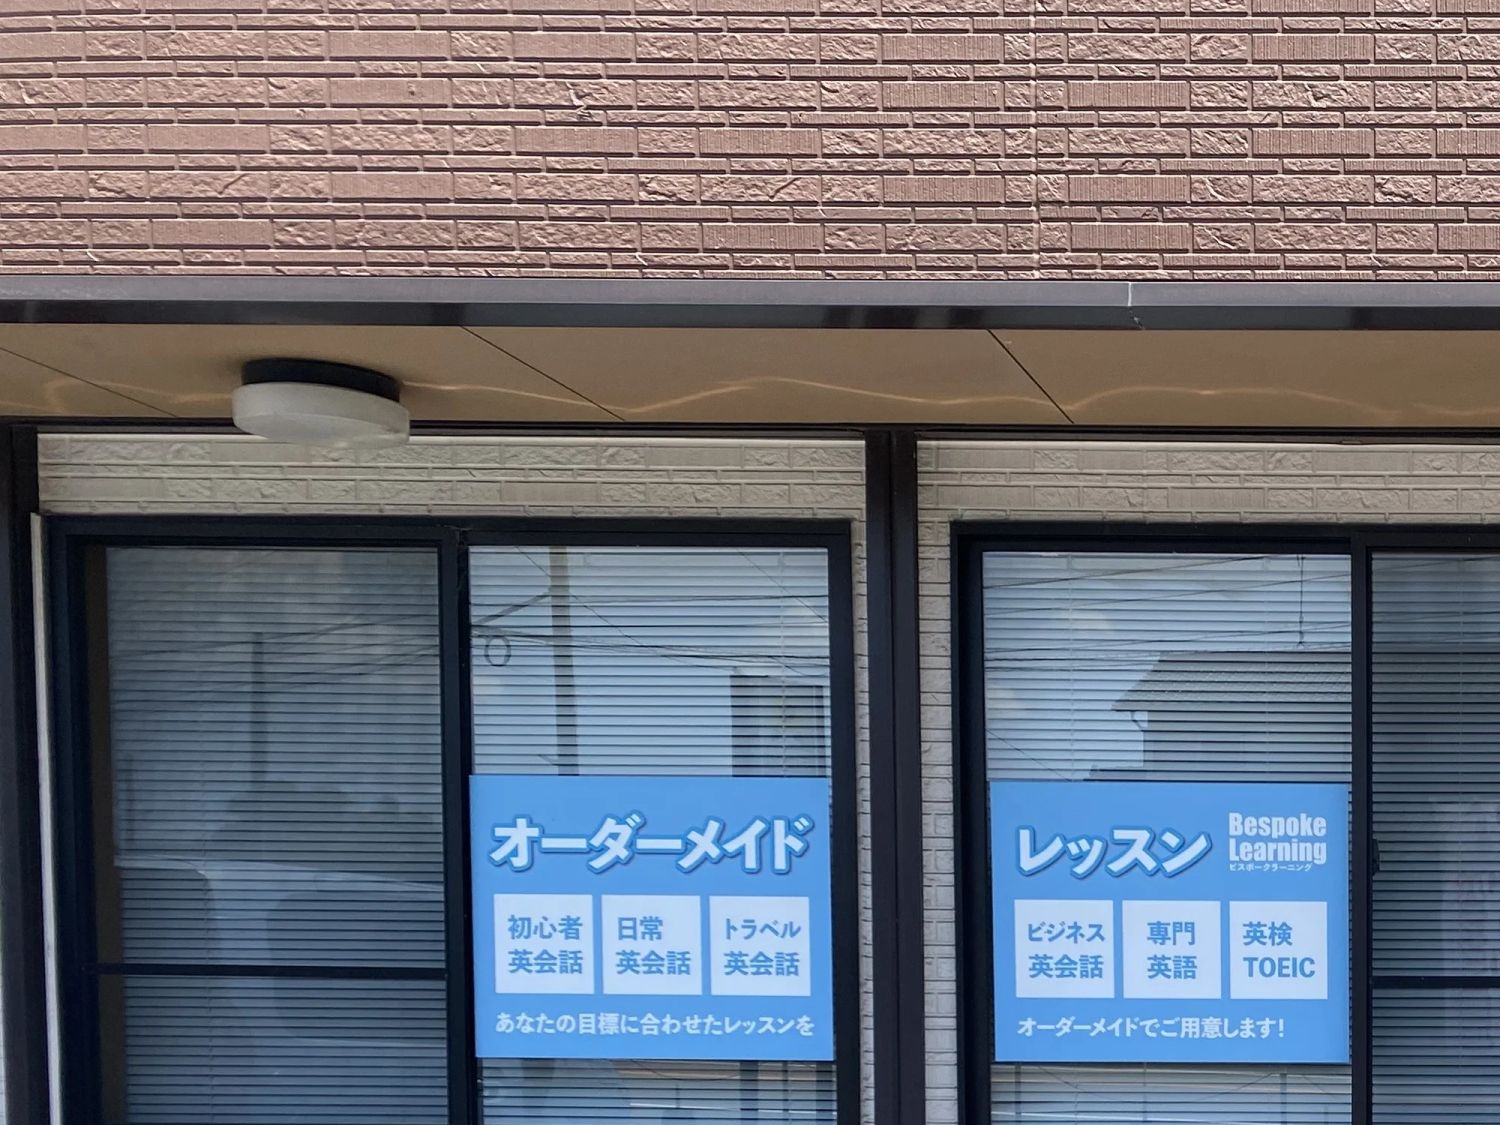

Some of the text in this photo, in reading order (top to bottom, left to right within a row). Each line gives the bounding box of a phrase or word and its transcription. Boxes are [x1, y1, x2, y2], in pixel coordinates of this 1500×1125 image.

[1228, 812, 1327, 837] Bespoke
[489, 812, 814, 872] オーダーメイド
[1017, 826, 1212, 878] レッスン
[1228, 839, 1327, 865] Learning
[1229, 864, 1313, 872] ビスポークラーニング
[507, 915, 583, 941] 初心者
[617, 916, 664, 941] 日常
[725, 918, 801, 941] トラベル
[1027, 922, 1105, 943] ビジネス
[1147, 922, 1196, 946] 専門
[1242, 922, 1293, 946] 英検
[508, 950, 583, 974] 英会話
[616, 950, 691, 976] 英会話
[724, 951, 800, 977] 英会話
[1028, 954, 1104, 979] 英会話
[1147, 955, 1198, 980] 英語
[1243, 957, 1315, 978] TOEIC
[495, 1012, 814, 1036] あなたの目標に合わせたレッスンを
